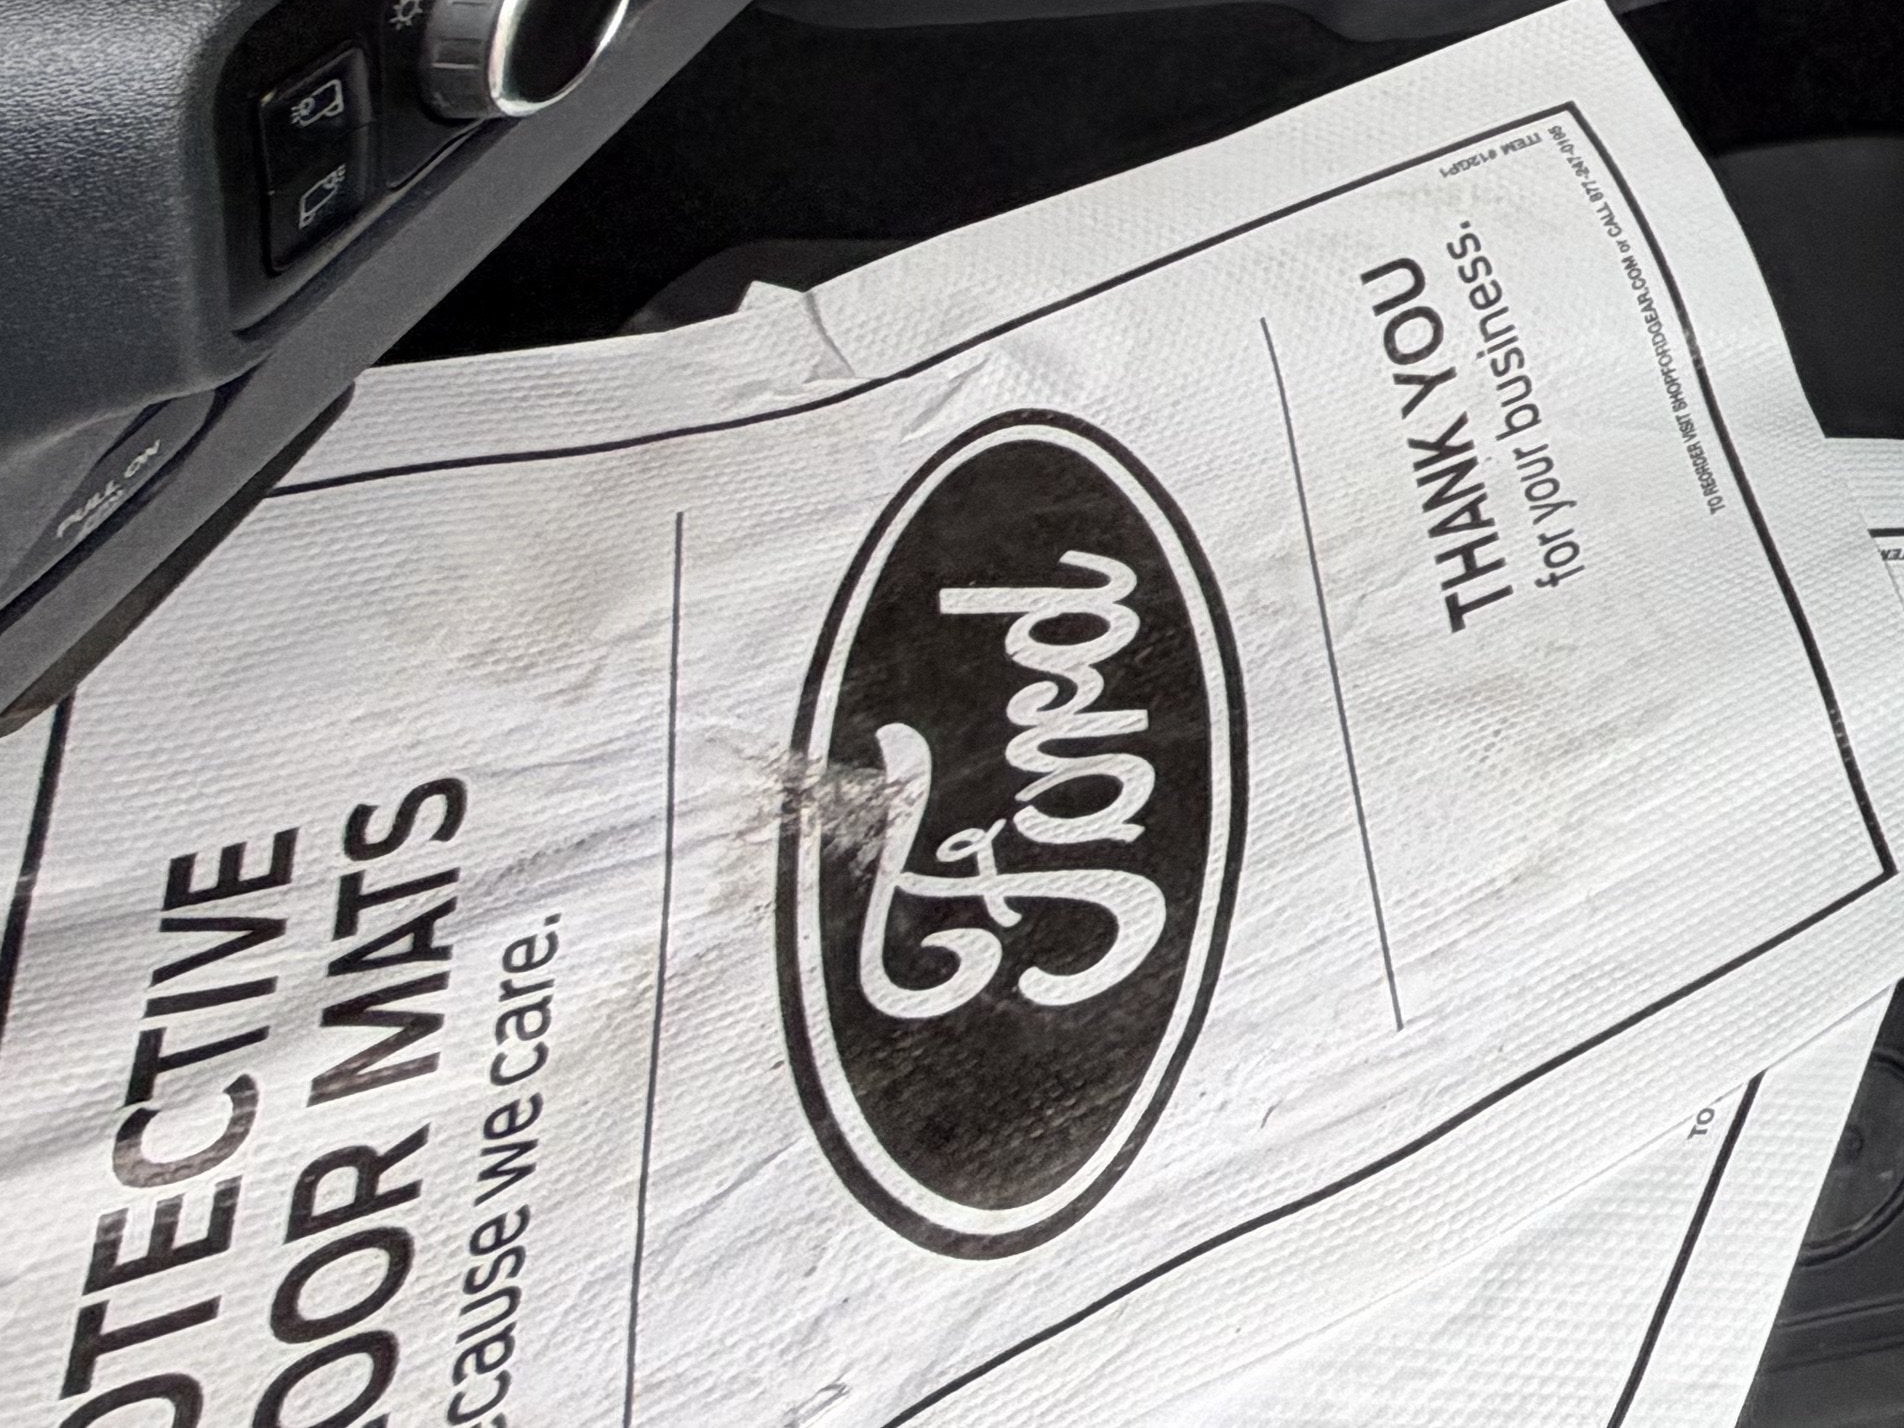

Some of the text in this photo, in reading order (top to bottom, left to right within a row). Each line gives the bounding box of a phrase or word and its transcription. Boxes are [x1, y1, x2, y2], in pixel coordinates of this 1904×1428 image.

[1596, 200, 1623, 239] CALL
[1360, 257, 1514, 634] THANK YOU
[1446, 220, 1586, 589] for your business.
[1675, 412, 1700, 444] VISIT
[1688, 440, 1723, 498] REORDER
[860, 550, 1167, 1020] Ford
[251, 776, 468, 1428] OOR MATS
[445, 912, 562, 1428] cause we care.
[1686, 1107, 1716, 1141] TO
